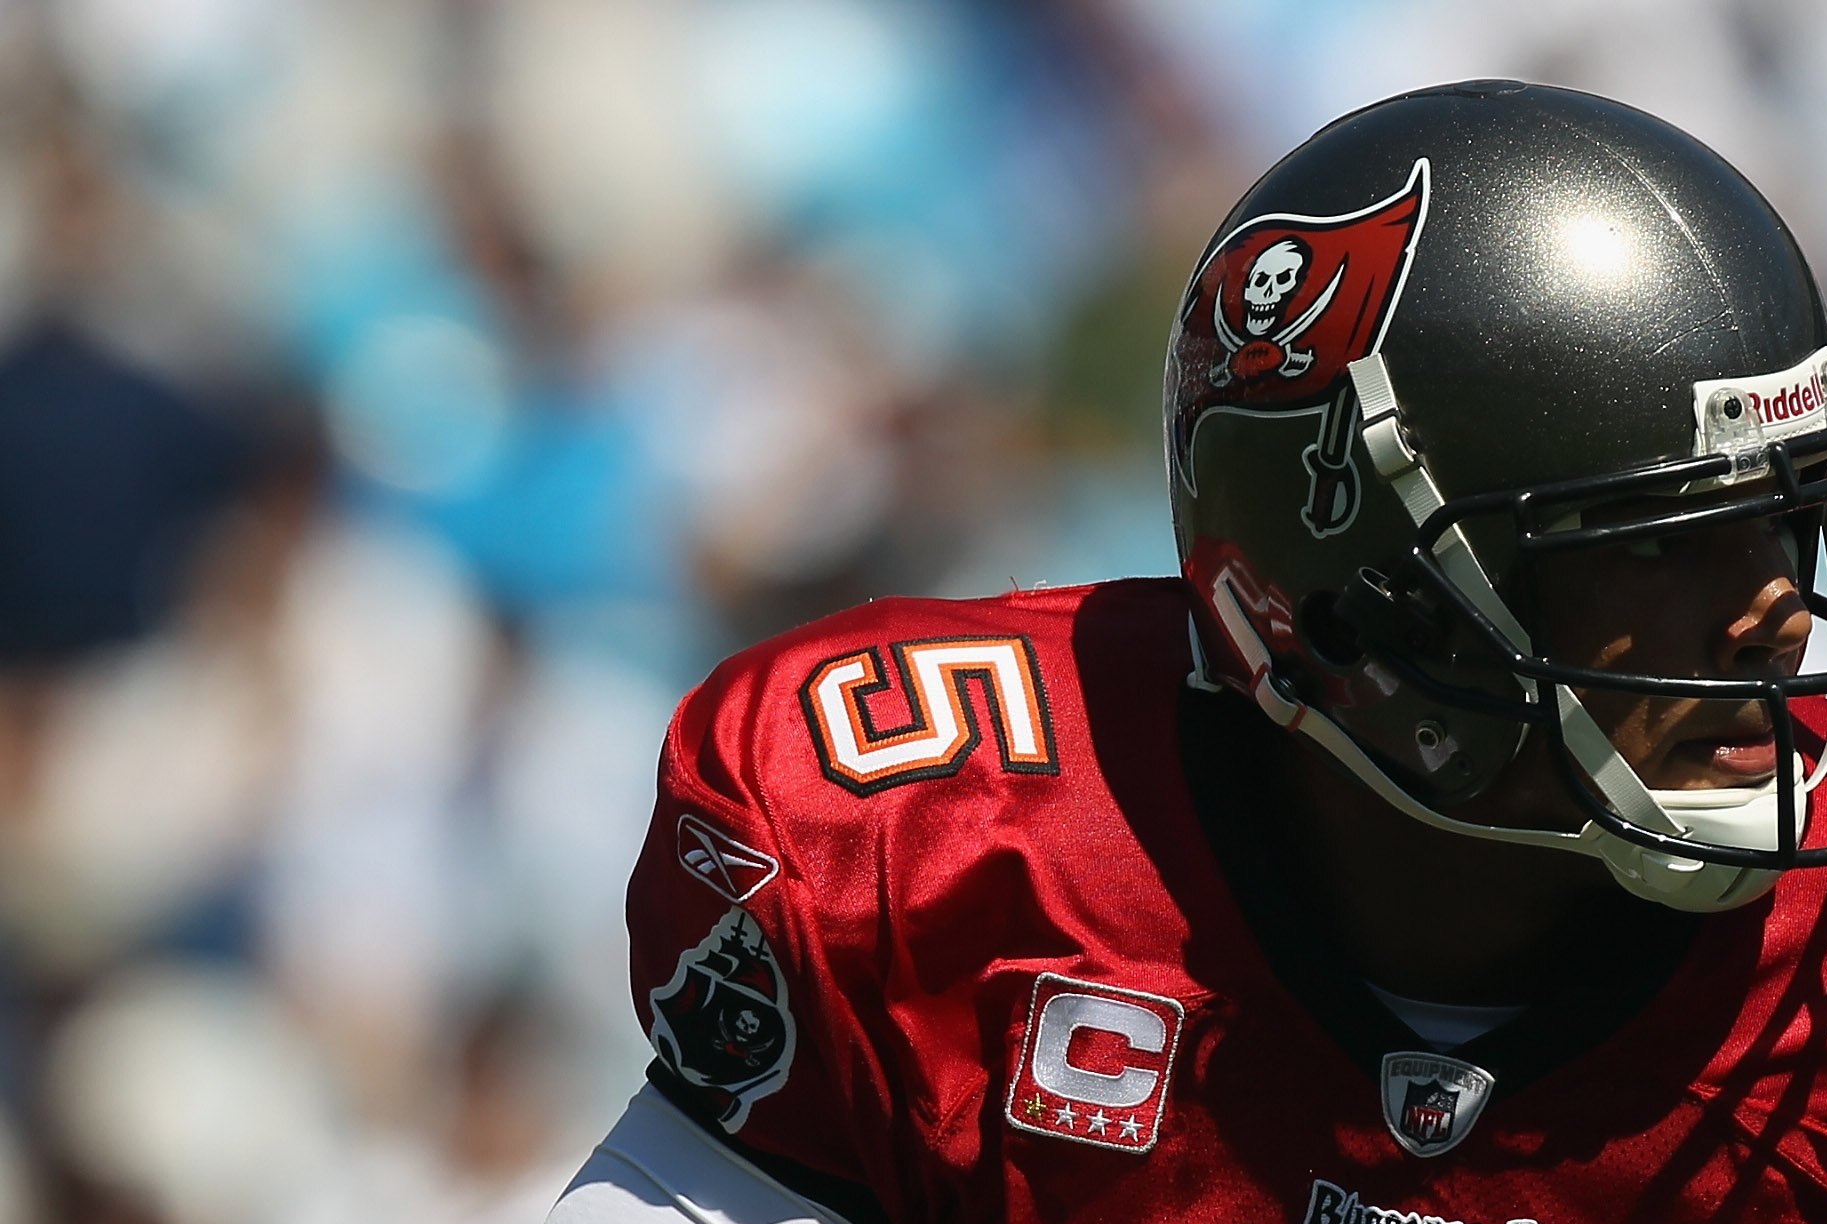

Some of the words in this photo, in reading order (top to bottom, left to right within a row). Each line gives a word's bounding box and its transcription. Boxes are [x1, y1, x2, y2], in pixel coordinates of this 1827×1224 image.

[1743, 373, 1827, 424] Riddell
[800, 635, 1060, 797] 5
[1032, 992, 1167, 1108] C
